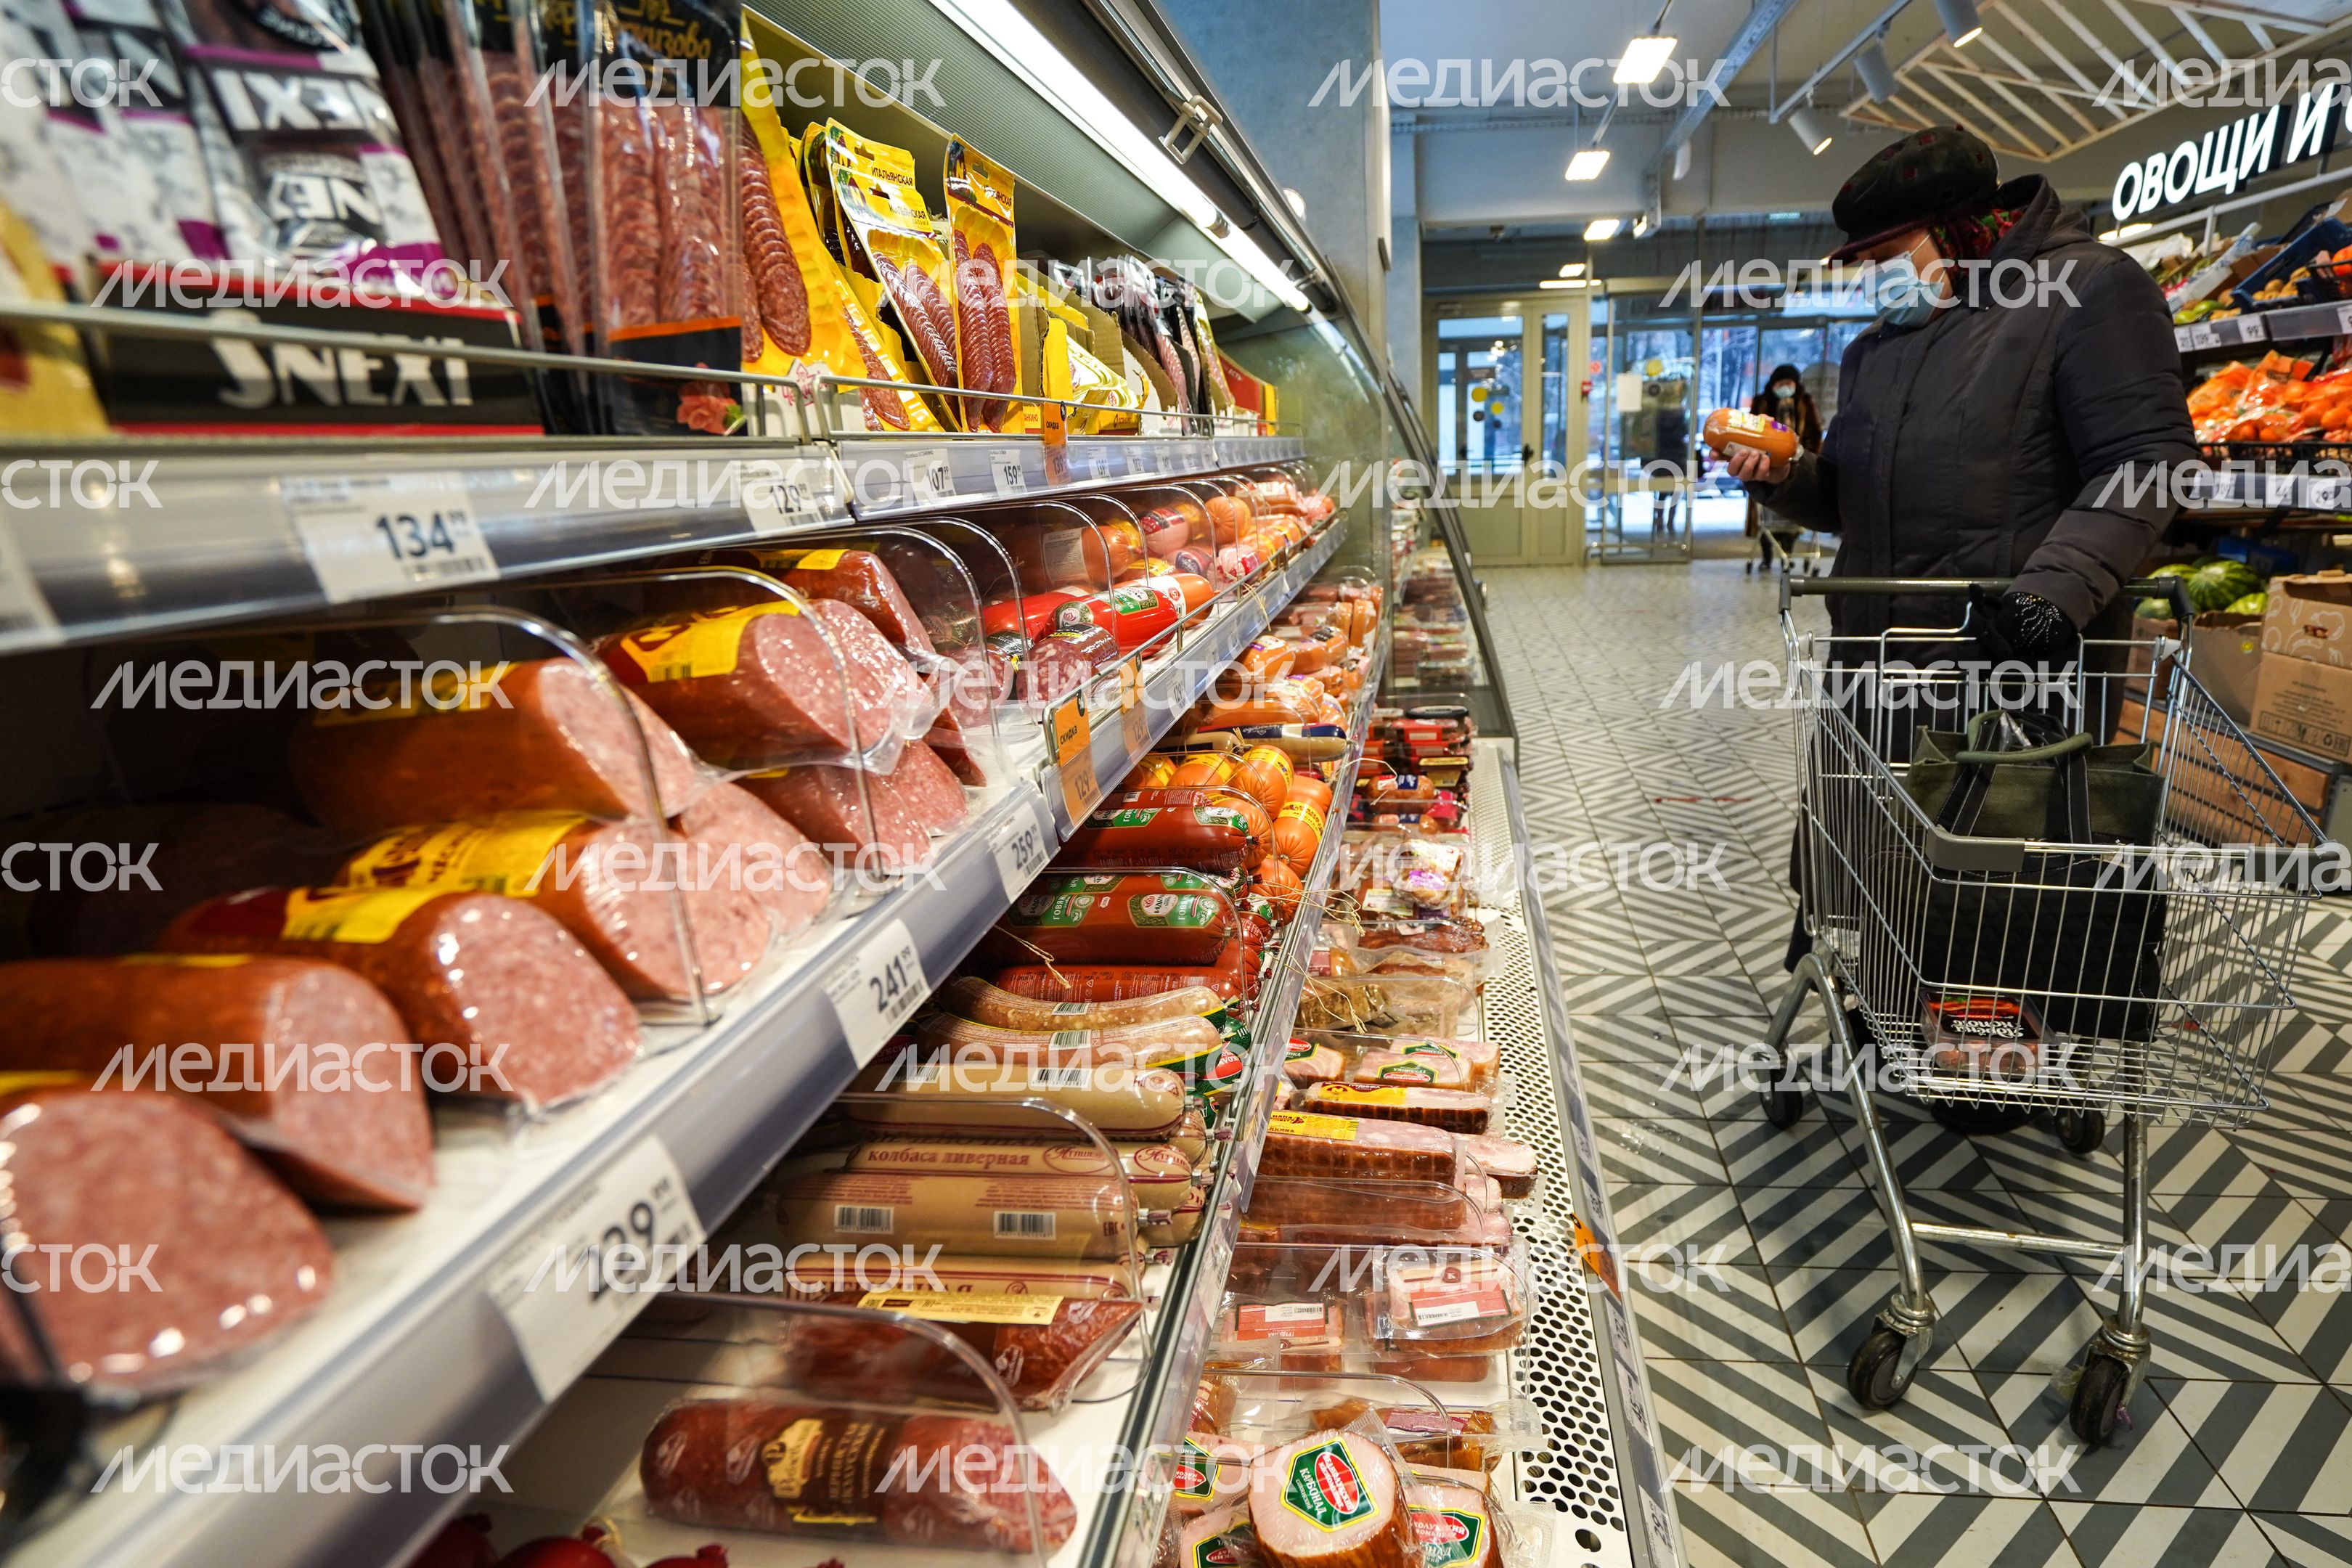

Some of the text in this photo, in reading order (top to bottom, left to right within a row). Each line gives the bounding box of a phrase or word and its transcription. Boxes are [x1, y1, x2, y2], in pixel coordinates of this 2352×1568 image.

[2112, 82, 2335, 221] ОВОЩИ И
[871, 166, 913, 187] ИТАЛЬЯНСКАЯ
[889, 203, 926, 220] ИЛЬЯНСКАЯ
[1045, 420, 1059, 431] скидка
[926, 466, 944, 492] 107
[1003, 465, 1018, 486] 159
[769, 483, 801, 515] 129
[375, 510, 454, 561] 134
[1058, 724, 1078, 746] скидка
[1074, 772, 1090, 801] 129
[1011, 830, 1034, 870] 259
[869, 955, 907, 1013] 241
[867, 1147, 1031, 1169] колбаса ливерная
[1299, 1467, 1328, 1516] КАРБОНАД
[1651, 1511, 1667, 1541] 29
